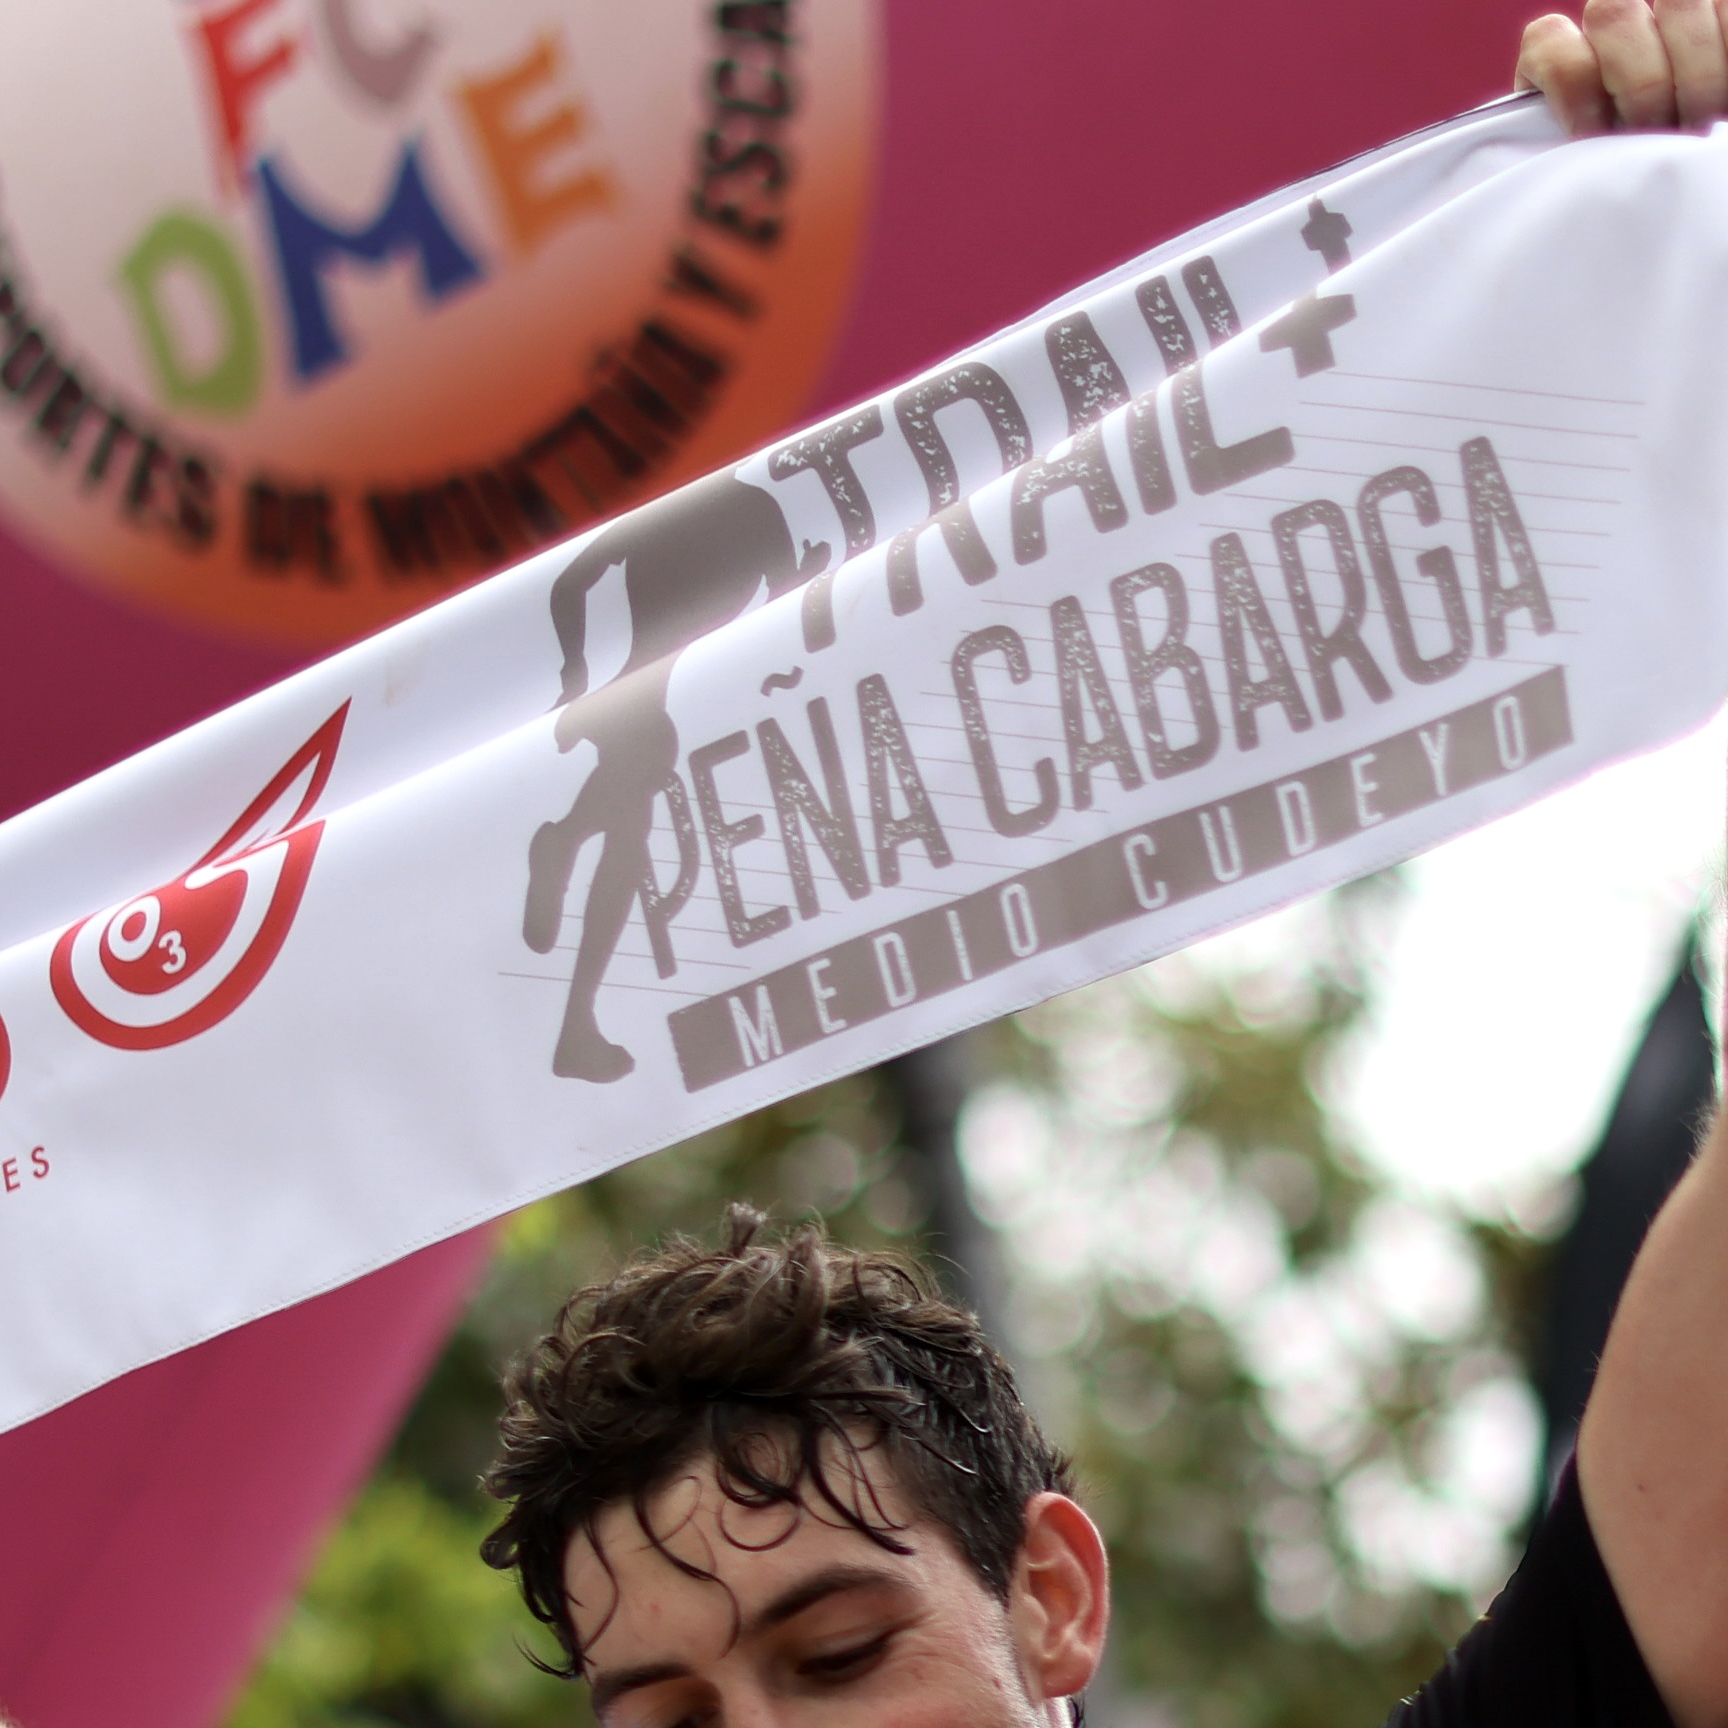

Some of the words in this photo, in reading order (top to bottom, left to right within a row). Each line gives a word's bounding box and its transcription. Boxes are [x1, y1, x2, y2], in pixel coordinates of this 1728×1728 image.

[244, 480, 344, 586] DE
[668, 250, 763, 318] Y
[637, 667, 955, 981] PEÑA
[950, 435, 1557, 840] CABARGA
[729, 883, 1039, 1070] MEDIO
[1124, 696, 1530, 911] CUDEYO
